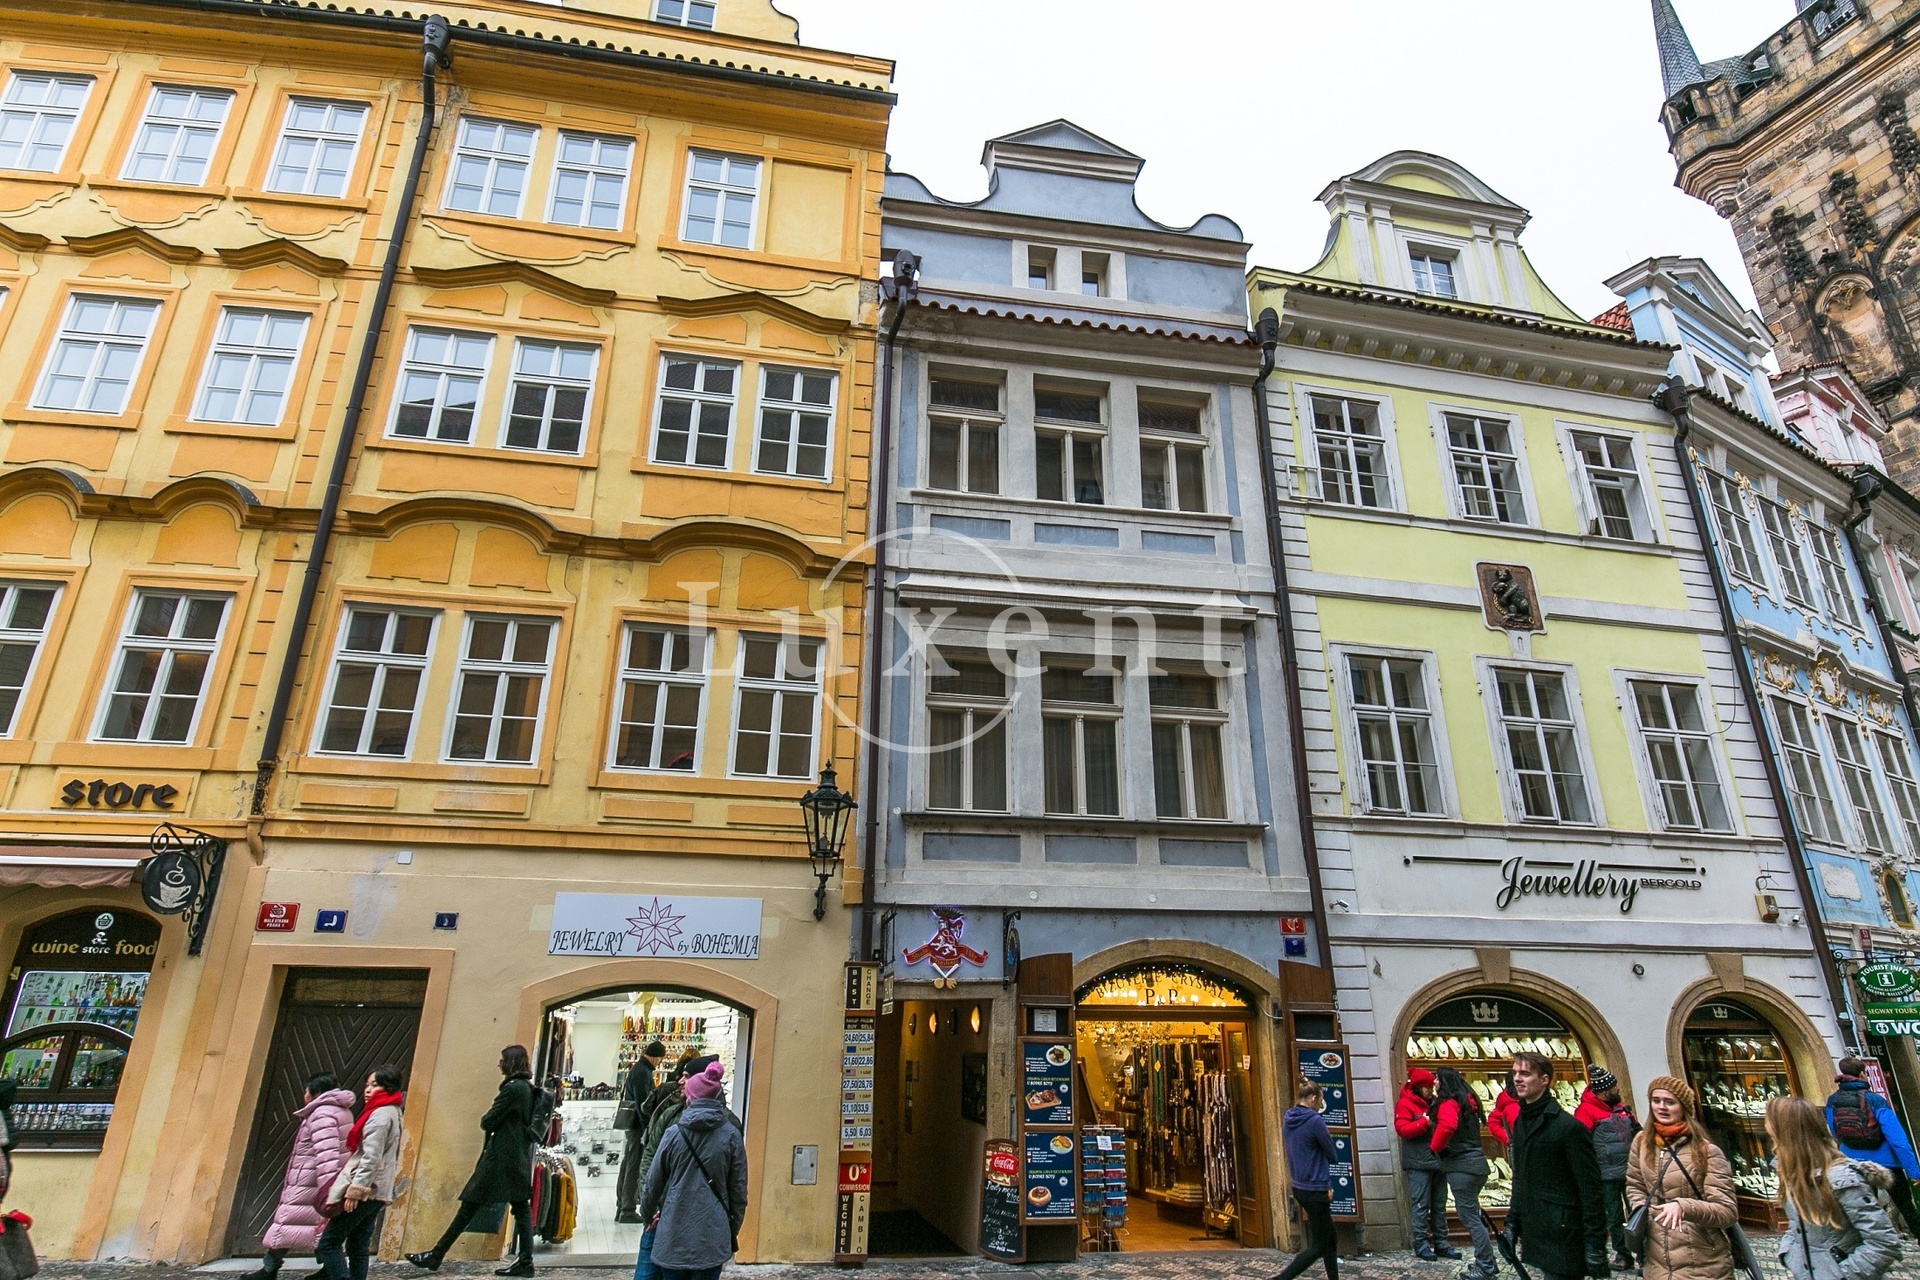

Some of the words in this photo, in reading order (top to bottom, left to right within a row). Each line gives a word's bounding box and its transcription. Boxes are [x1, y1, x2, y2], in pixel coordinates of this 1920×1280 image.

[61, 779, 178, 808] store
[1496, 856, 1639, 914] Jewellery
[31, 939, 79, 954] wine
[82, 945, 110, 954] store
[115, 940, 157, 956] food
[549, 928, 629, 956] JEWELRY
[677, 940, 690, 955] by
[691, 933, 760, 957] BOHEMIA
[1860, 964, 1888, 976] TOURIST
[1890, 964, 1910, 975] INFO
[1145, 988, 1155, 1005] P
[1168, 988, 1178, 1005] P
[848, 1163, 867, 1182] 0%
[839, 1183, 870, 1191] COMMISSION
[841, 1195, 850, 1254] WECHSEL
[856, 1195, 865, 1254] CAMBIO
